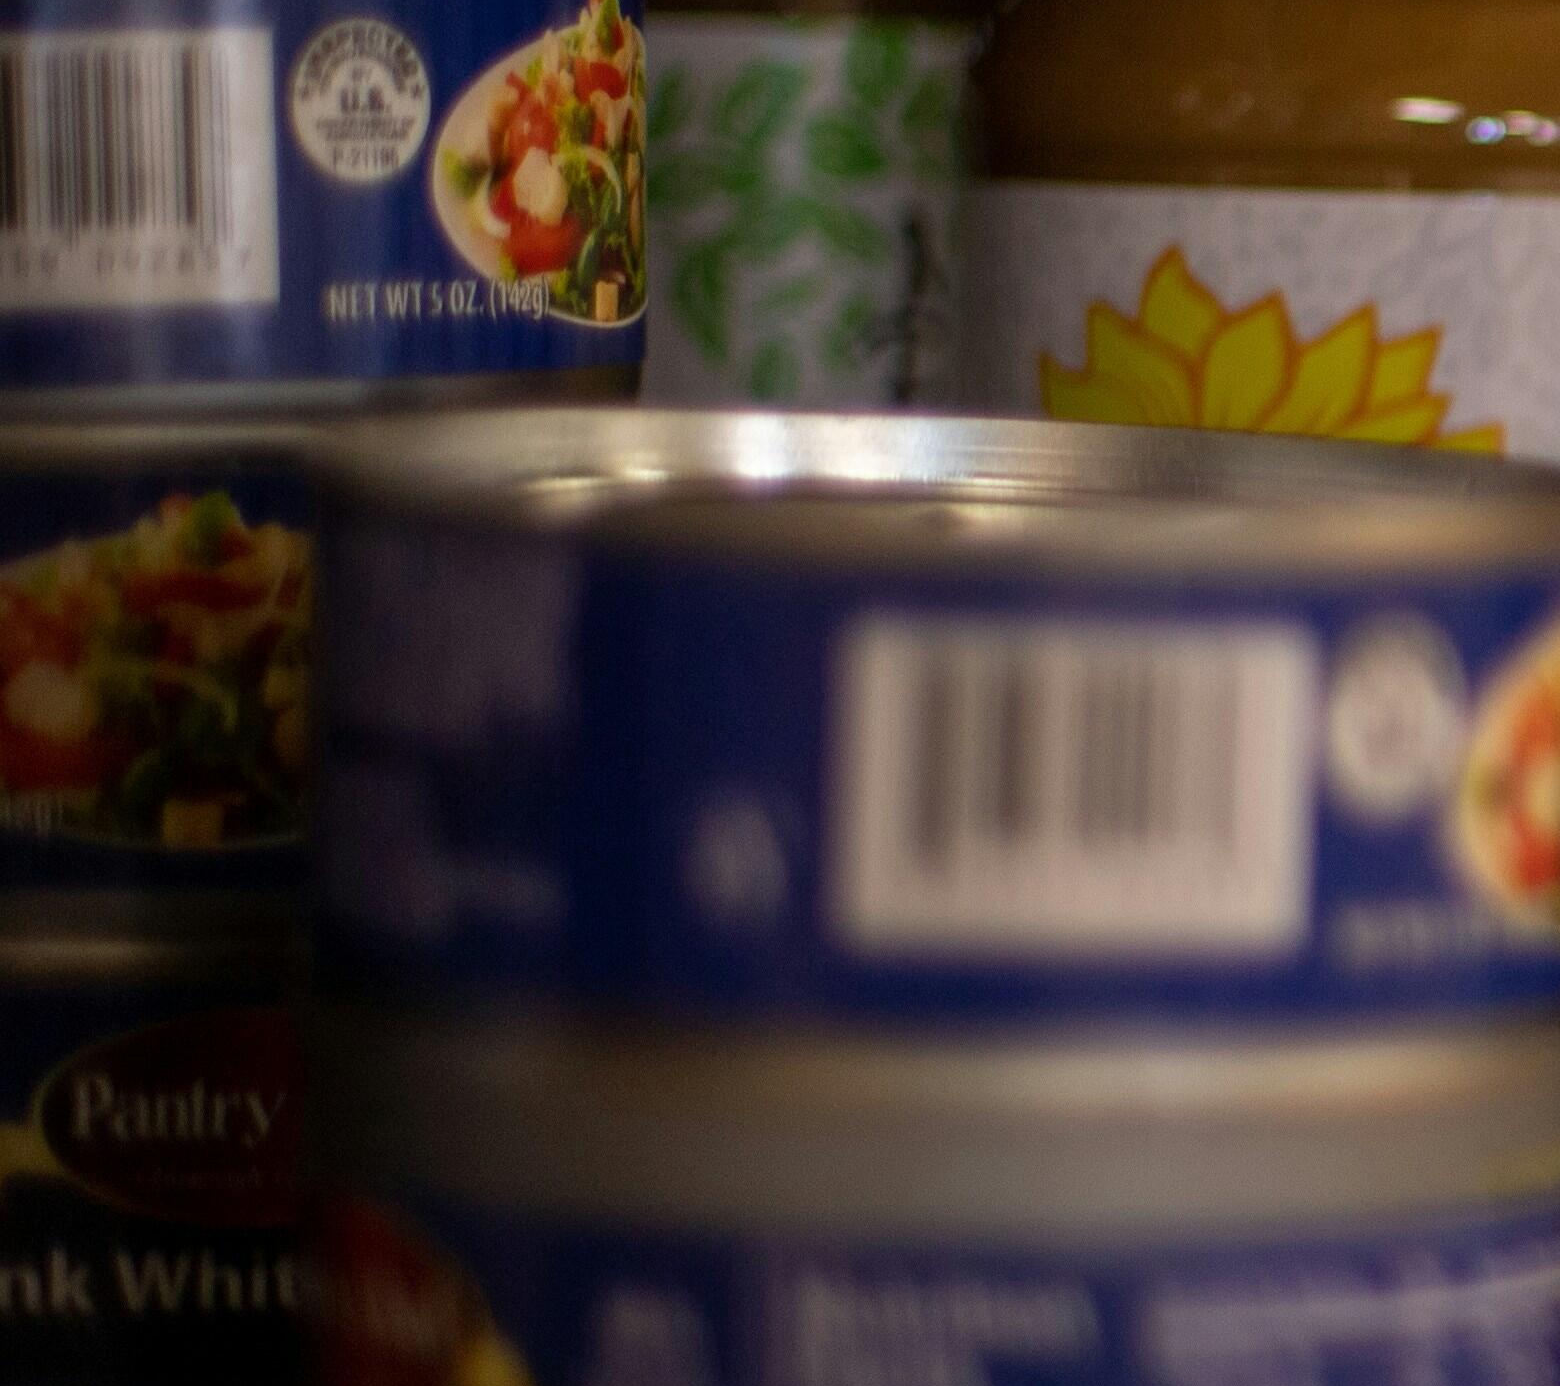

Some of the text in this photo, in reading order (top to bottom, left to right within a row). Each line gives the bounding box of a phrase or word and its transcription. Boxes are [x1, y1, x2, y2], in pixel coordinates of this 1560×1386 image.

[329, 276, 551, 323] NET WT 5 OZ. (142g)
[69, 1070, 285, 1151] Pantry
[111, 1245, 303, 1317] Whit
